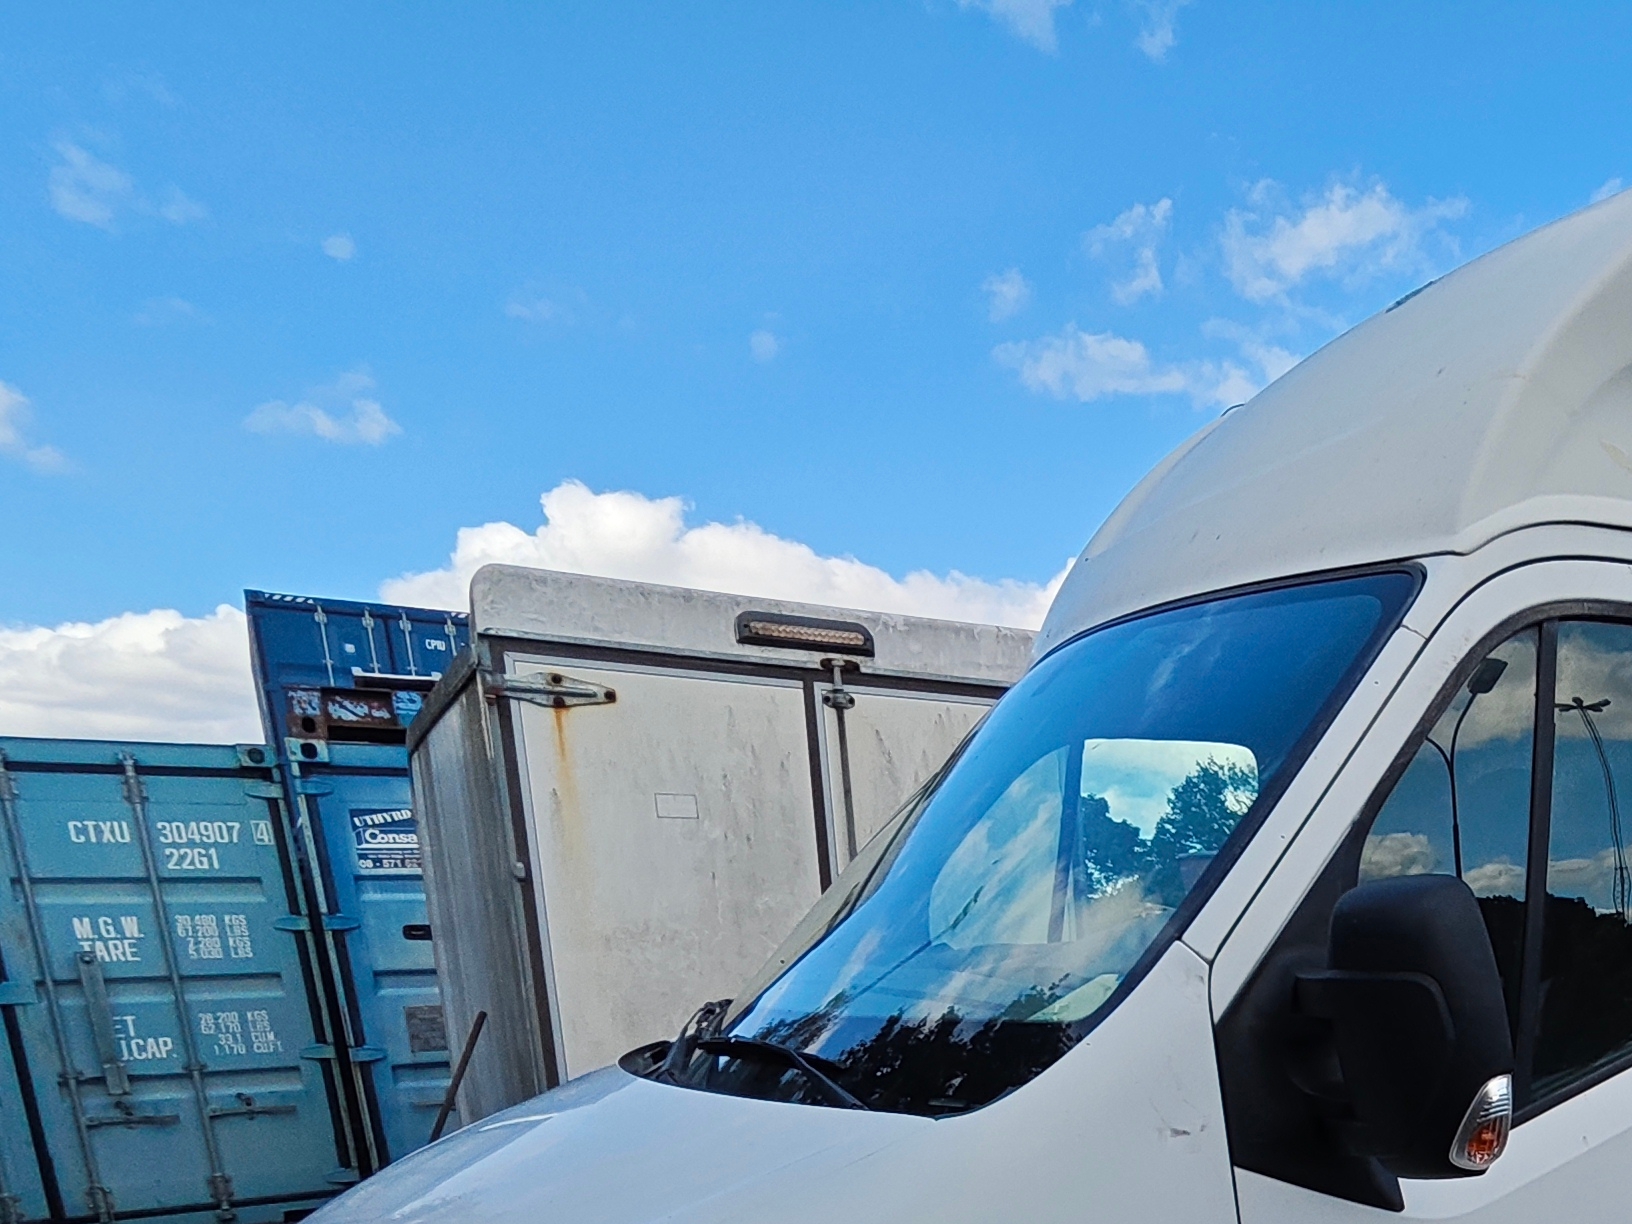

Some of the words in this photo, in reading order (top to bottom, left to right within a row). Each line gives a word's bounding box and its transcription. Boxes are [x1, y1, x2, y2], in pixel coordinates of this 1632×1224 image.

[67, 820, 131, 843] CTXU
[156, 821, 241, 843] 304907
[165, 848, 220, 869] 22G1
[113, 1015, 136, 1037] ET
